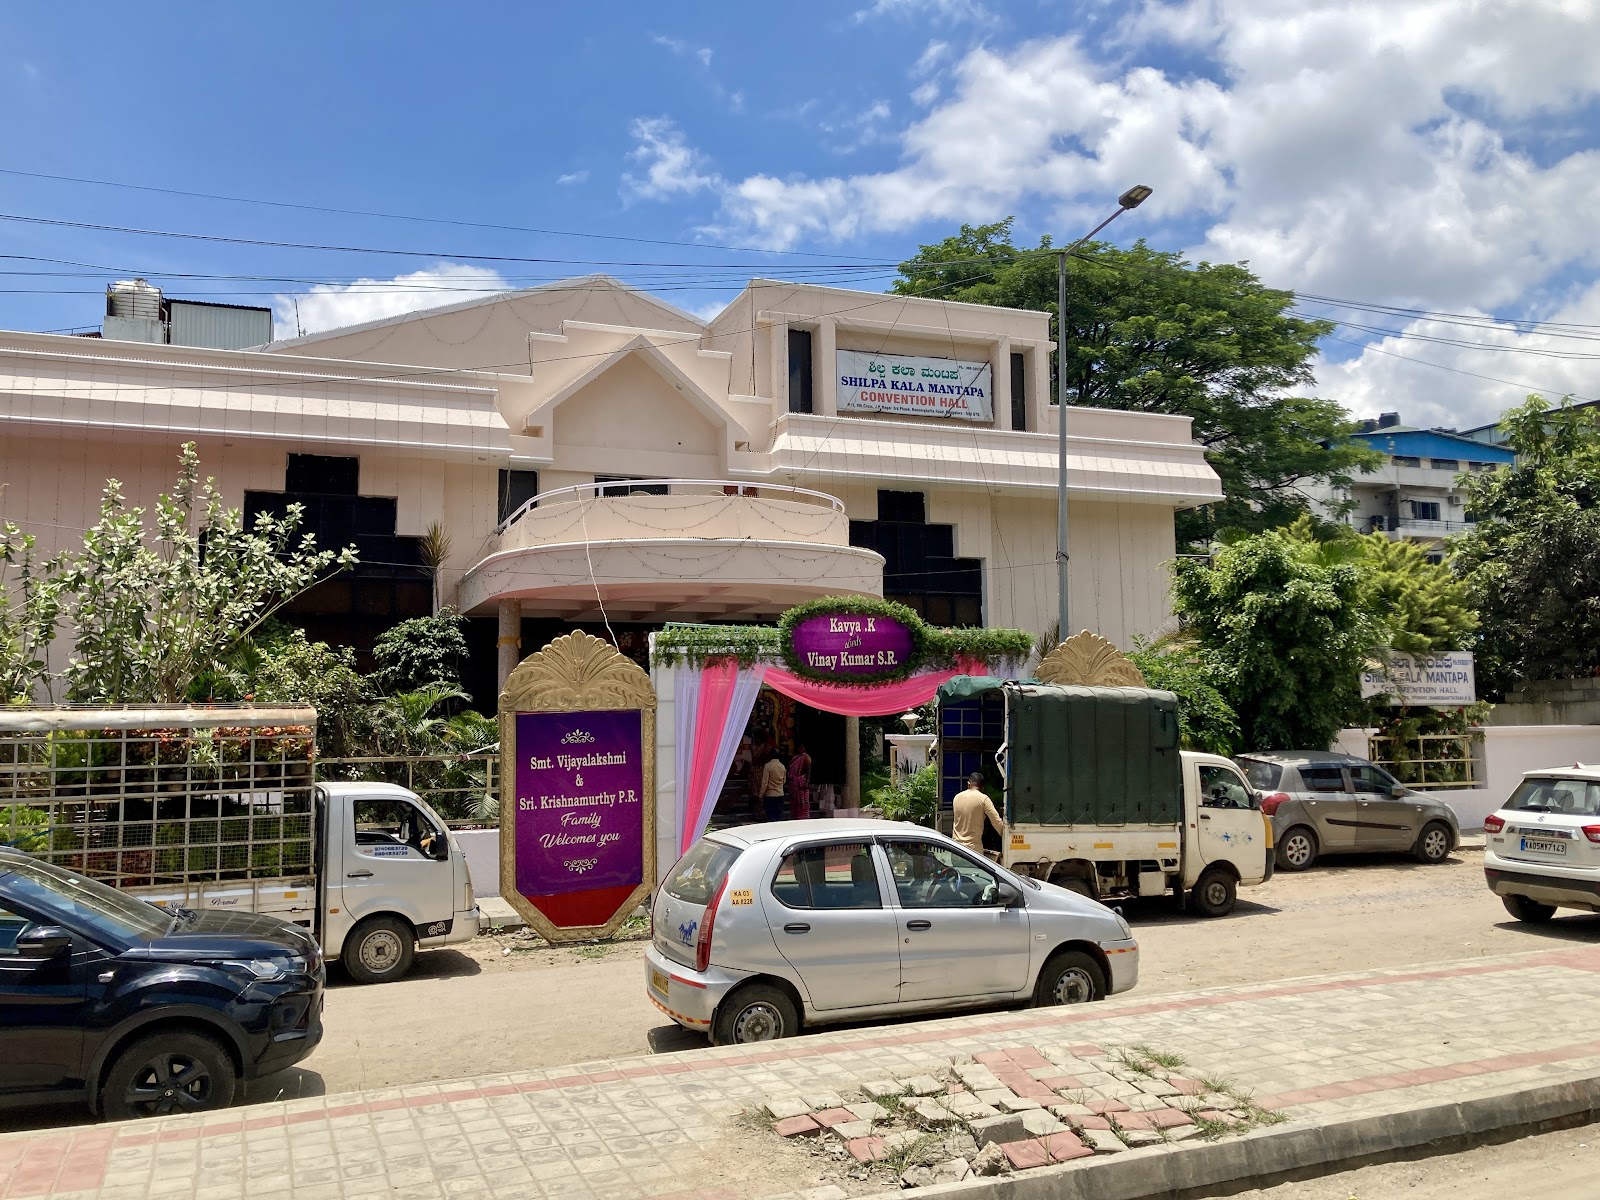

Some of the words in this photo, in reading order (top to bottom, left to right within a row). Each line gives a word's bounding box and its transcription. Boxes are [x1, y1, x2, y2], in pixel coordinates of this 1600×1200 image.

[868, 362, 886, 378] ಶಿಲ್ಪ
[892, 364, 915, 376] ಕಲಾ
[921, 366, 959, 380] ಮಂಟಪ
[841, 376, 887, 389] SHILPA
[890, 380, 924, 392] KALA
[928, 384, 984, 398] MANTAPA
[860, 391, 936, 406] CONVENTION
[940, 397, 968, 409] HALL
[830, 618, 861, 636] Kavya
[864, 618, 876, 632] .K
[807, 652, 837, 670] Vinay
[840, 652, 874, 666] Kumar
[877, 651, 898, 666] S.R.
[1426, 672, 1469, 683] MANTAPA
[1384, 686, 1437, 694] COVENTION
[1440, 686, 1458, 694] HALL
[530, 756, 554, 770] Smt.
[557, 751, 626, 771] Vijayalakshmi
[575, 774, 584, 786] &
[520, 797, 537, 810] Sri.
[540, 792, 616, 810] Krishnamurthy
[618, 790, 638, 803] P.R.
[560, 812, 601, 828] Family
[539, 832, 596, 848] Welcomes
[597, 832, 620, 847] you
